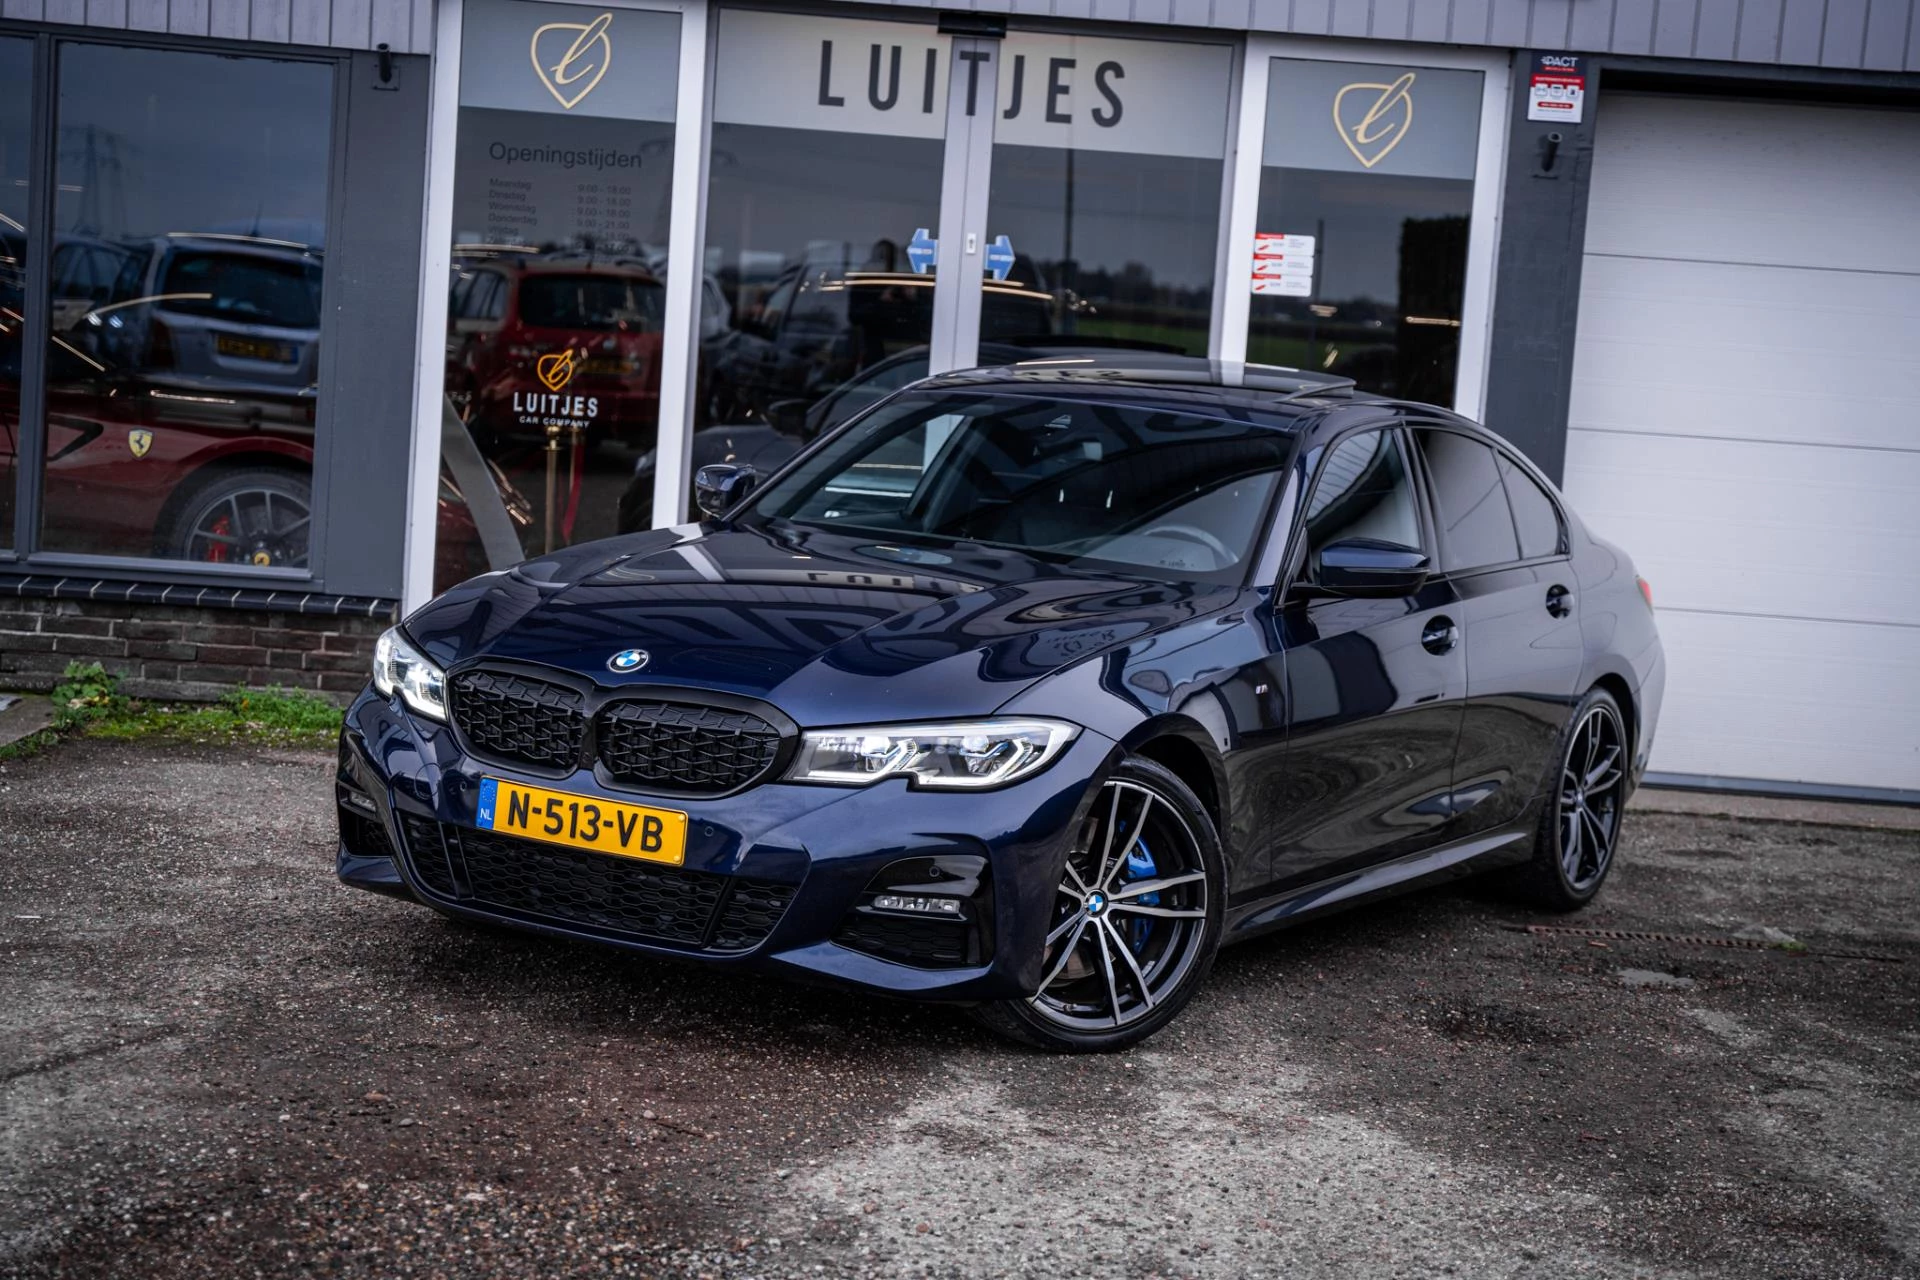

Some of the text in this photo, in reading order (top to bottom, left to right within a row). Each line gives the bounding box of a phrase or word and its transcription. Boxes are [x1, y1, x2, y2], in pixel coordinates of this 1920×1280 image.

[818, 40, 1126, 128] LUITJES
[488, 142, 643, 171] Openingstijden
[513, 391, 598, 418] LUITJES
[519, 415, 590, 429] CAR COMPANY
[480, 807, 492, 821] NL
[507, 790, 664, 853] N-513-VB
